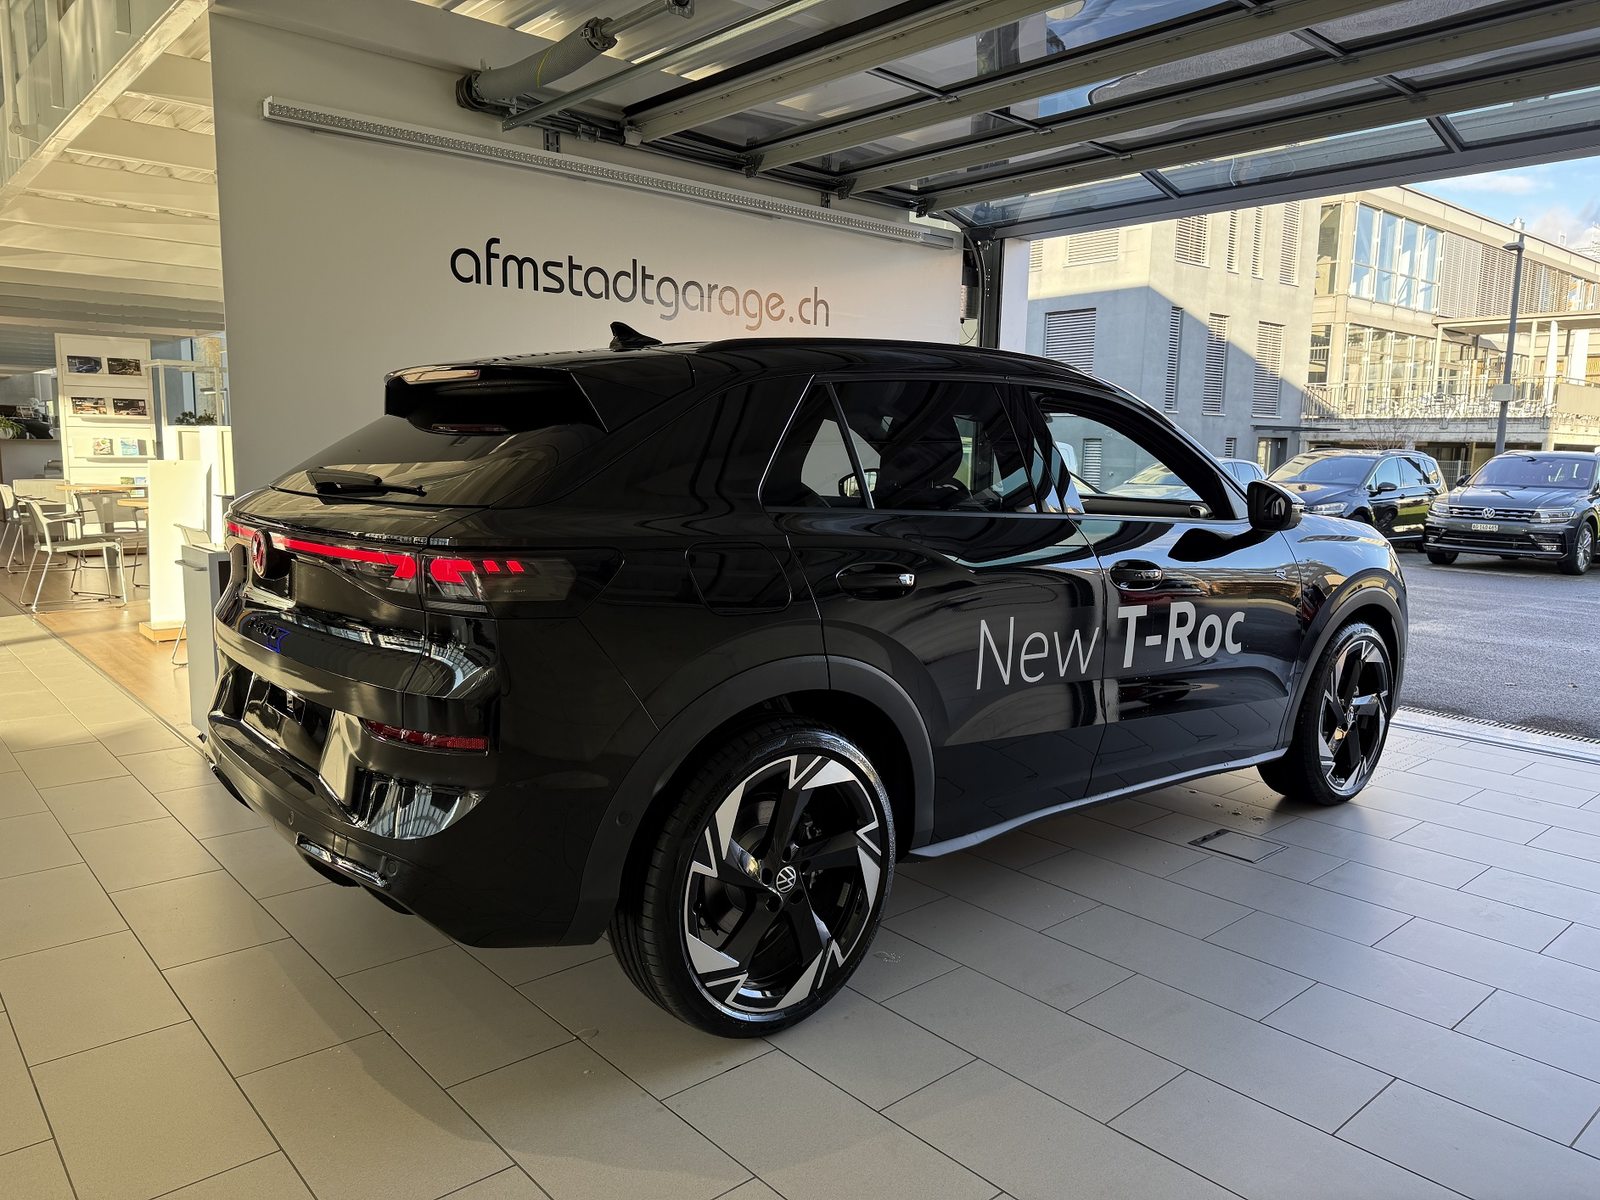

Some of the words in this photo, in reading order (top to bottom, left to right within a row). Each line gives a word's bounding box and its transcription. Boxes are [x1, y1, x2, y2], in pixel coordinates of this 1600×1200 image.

[450, 237, 830, 331] afmstadtgarage.ch
[976, 616, 1100, 690] New
[1117, 601, 1246, 668] T-Roc
